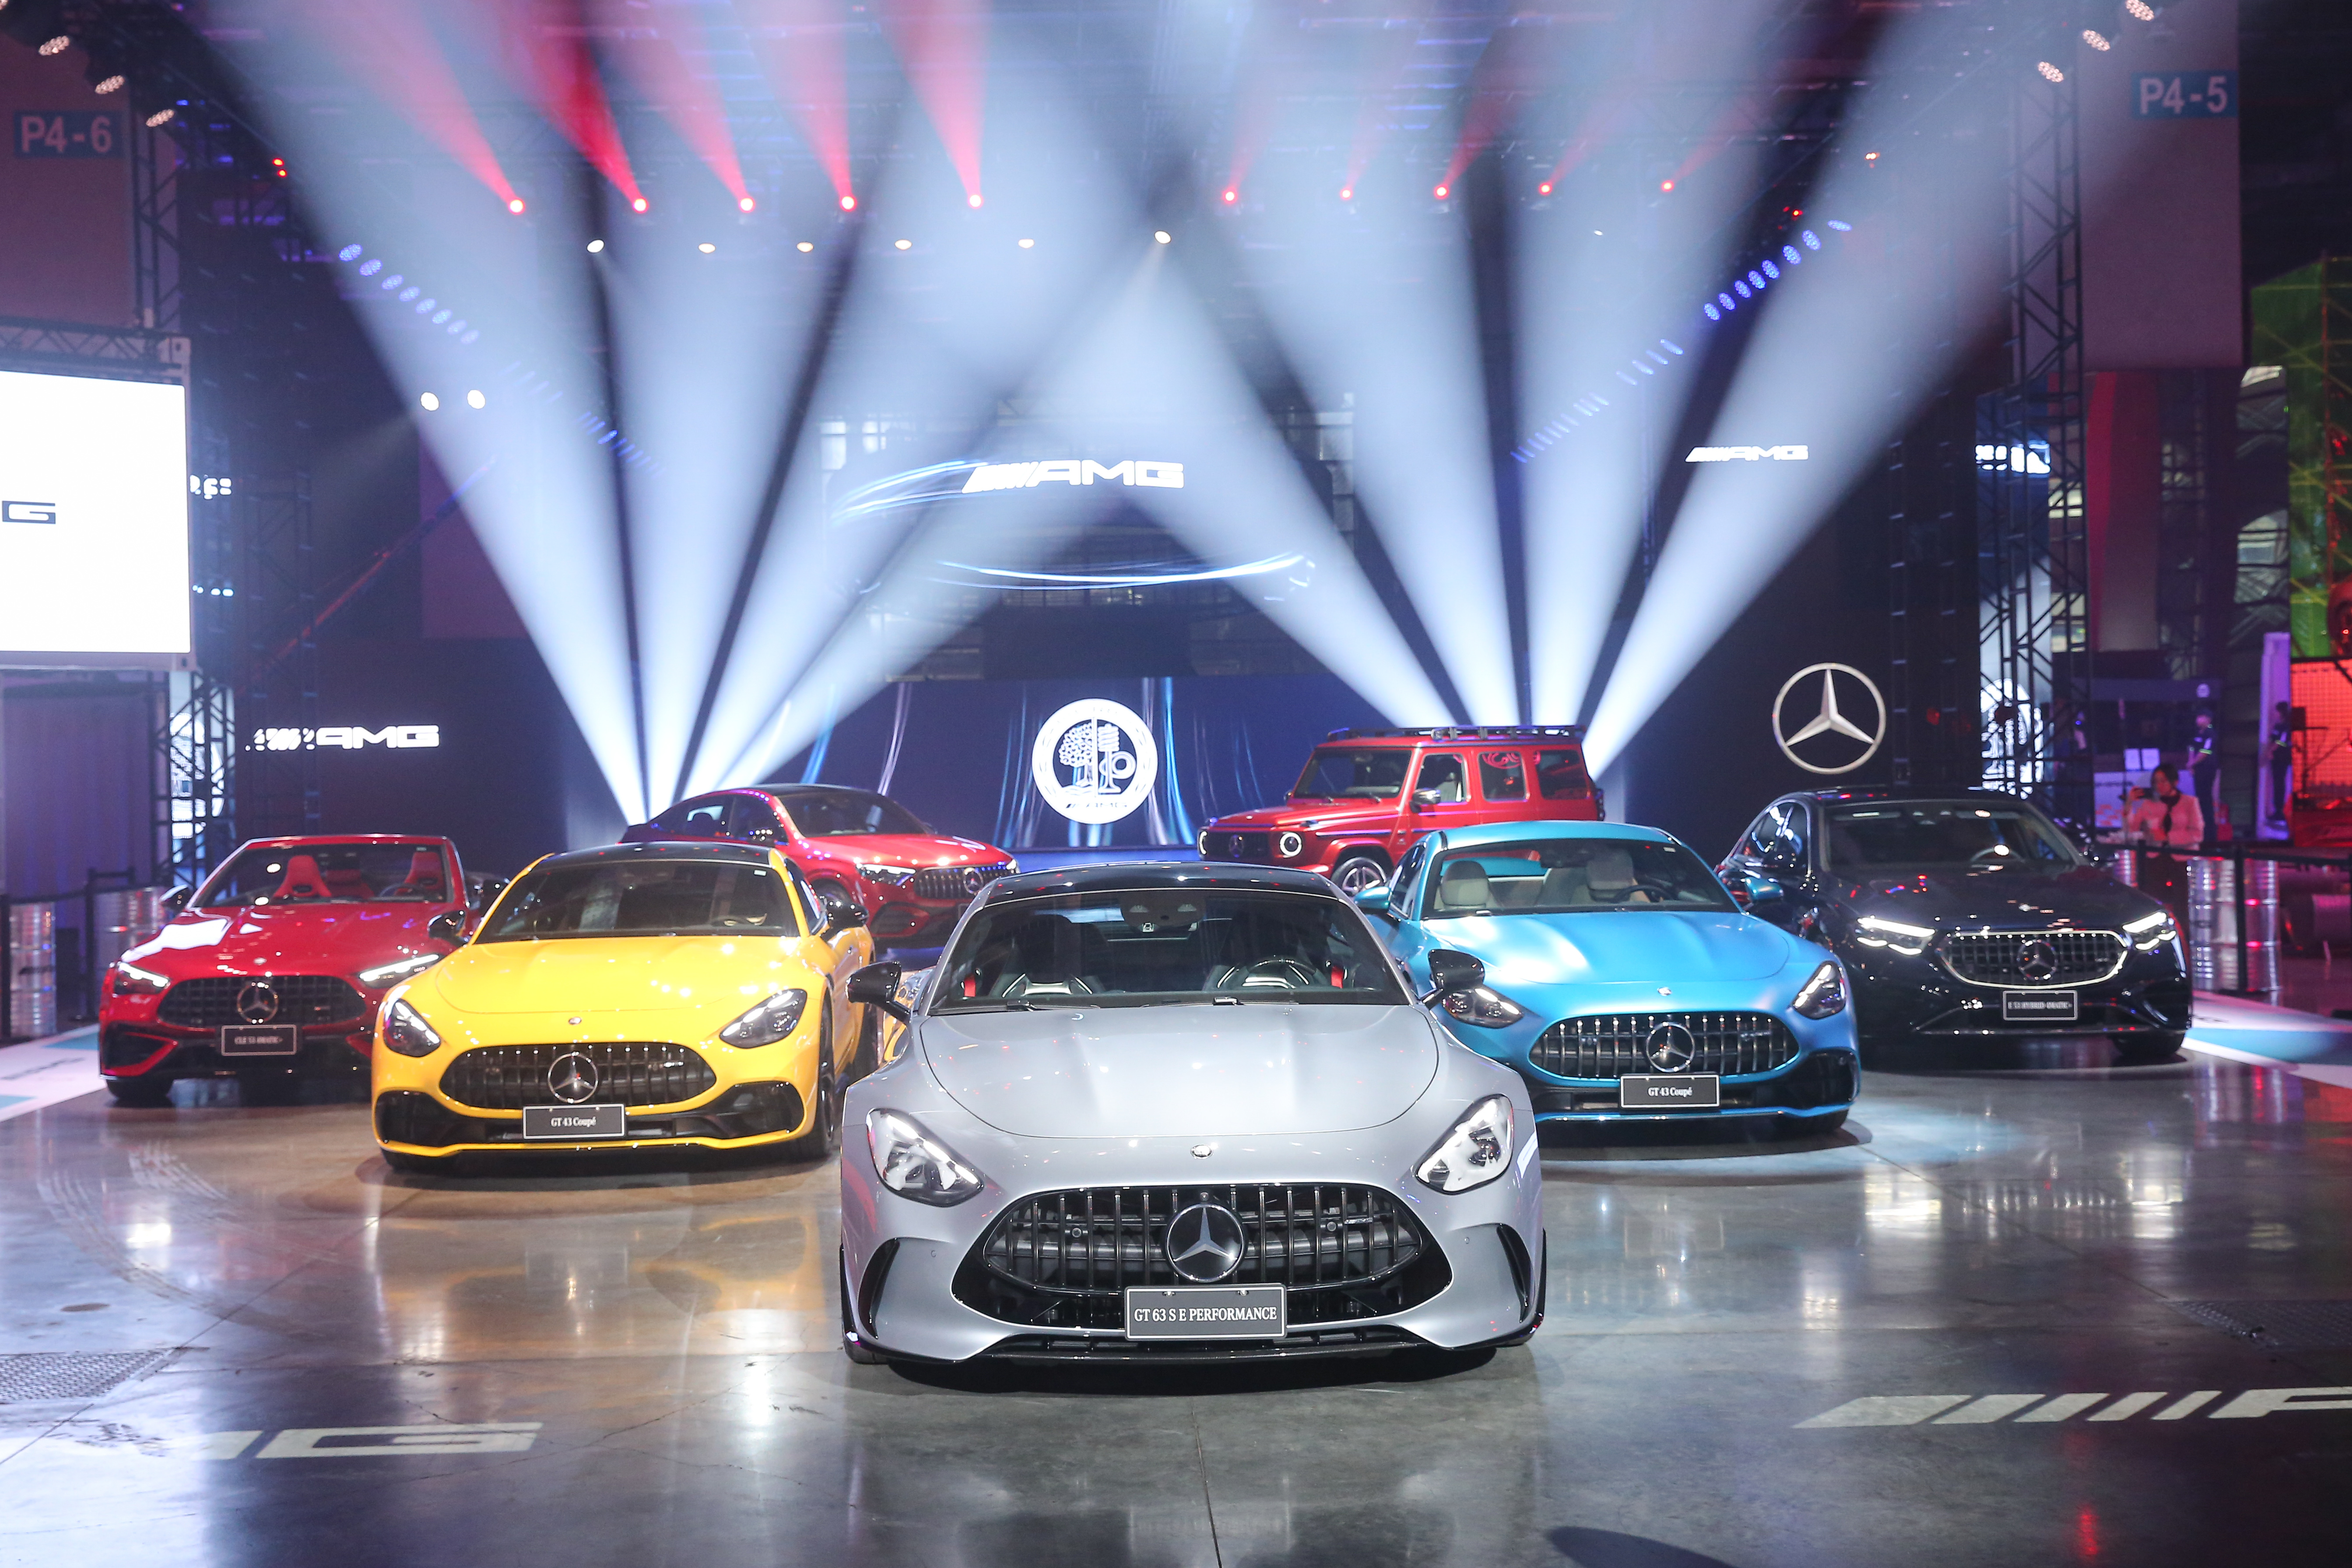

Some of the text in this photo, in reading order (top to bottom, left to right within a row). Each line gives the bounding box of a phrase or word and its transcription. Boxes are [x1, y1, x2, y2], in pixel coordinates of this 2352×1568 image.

[2140, 76, 2227, 114] P4-5
[21, 115, 112, 153] P4-6
[1722, 445, 1808, 462] AMG
[1025, 460, 1183, 488] AMG
[304, 725, 439, 749] AMG
[1648, 1087, 1692, 1098] GT 43 Coupé
[551, 1116, 596, 1128] GT 43 Coupé
[1134, 1306, 1277, 1321] GT 63 S E PERFORMANCE
